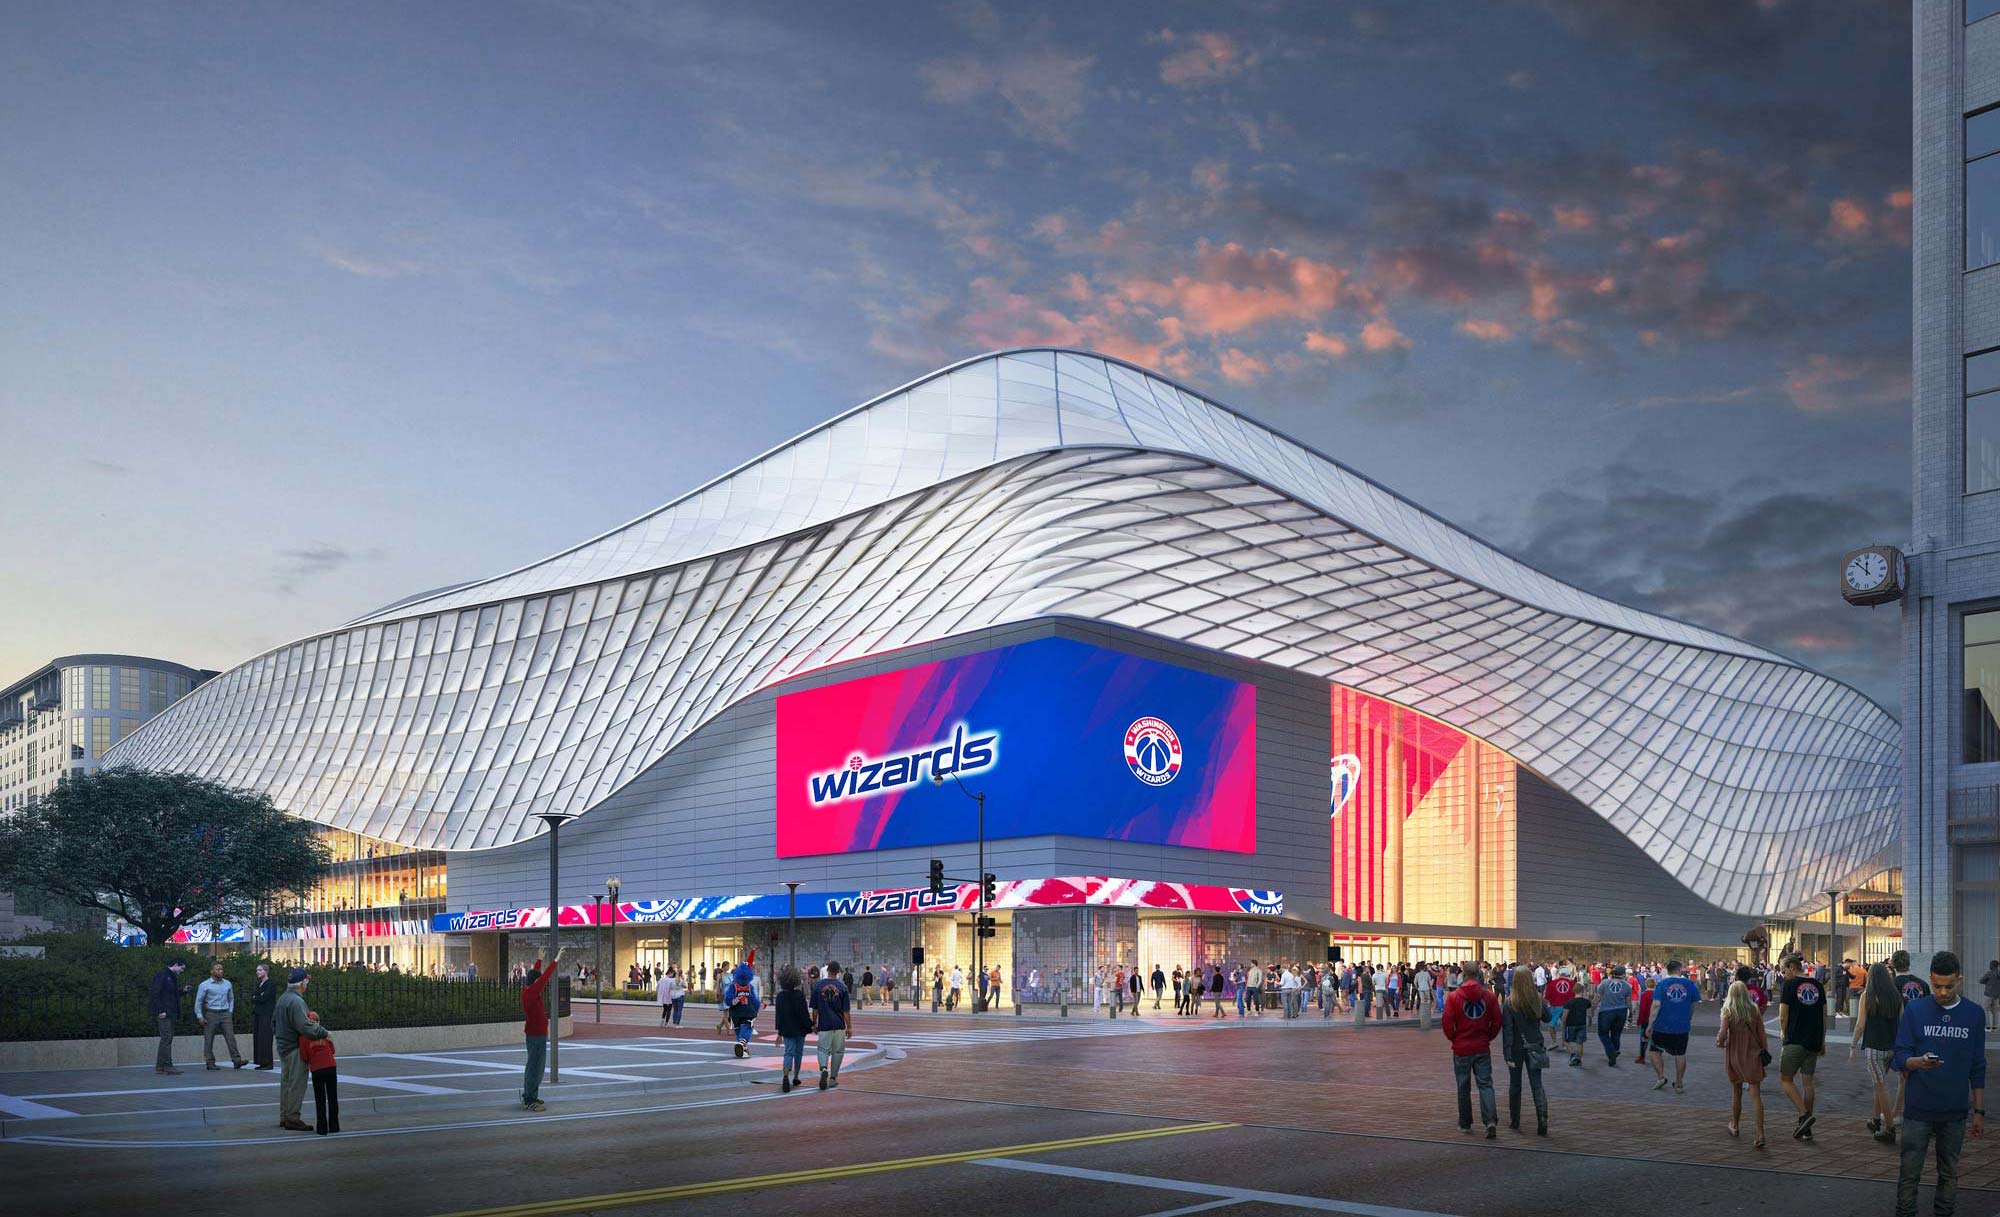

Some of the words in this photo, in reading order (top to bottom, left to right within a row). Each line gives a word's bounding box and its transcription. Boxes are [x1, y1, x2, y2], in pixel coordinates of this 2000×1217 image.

[1131, 720, 1176, 742] WASHINGTON
[813, 725, 997, 803] wizards
[1136, 767, 1171, 783] WIZARDS
[451, 909, 518, 930] wizards
[634, 899, 680, 922] WIZARDS
[1923, 1025, 1970, 1039] WIZARDS
